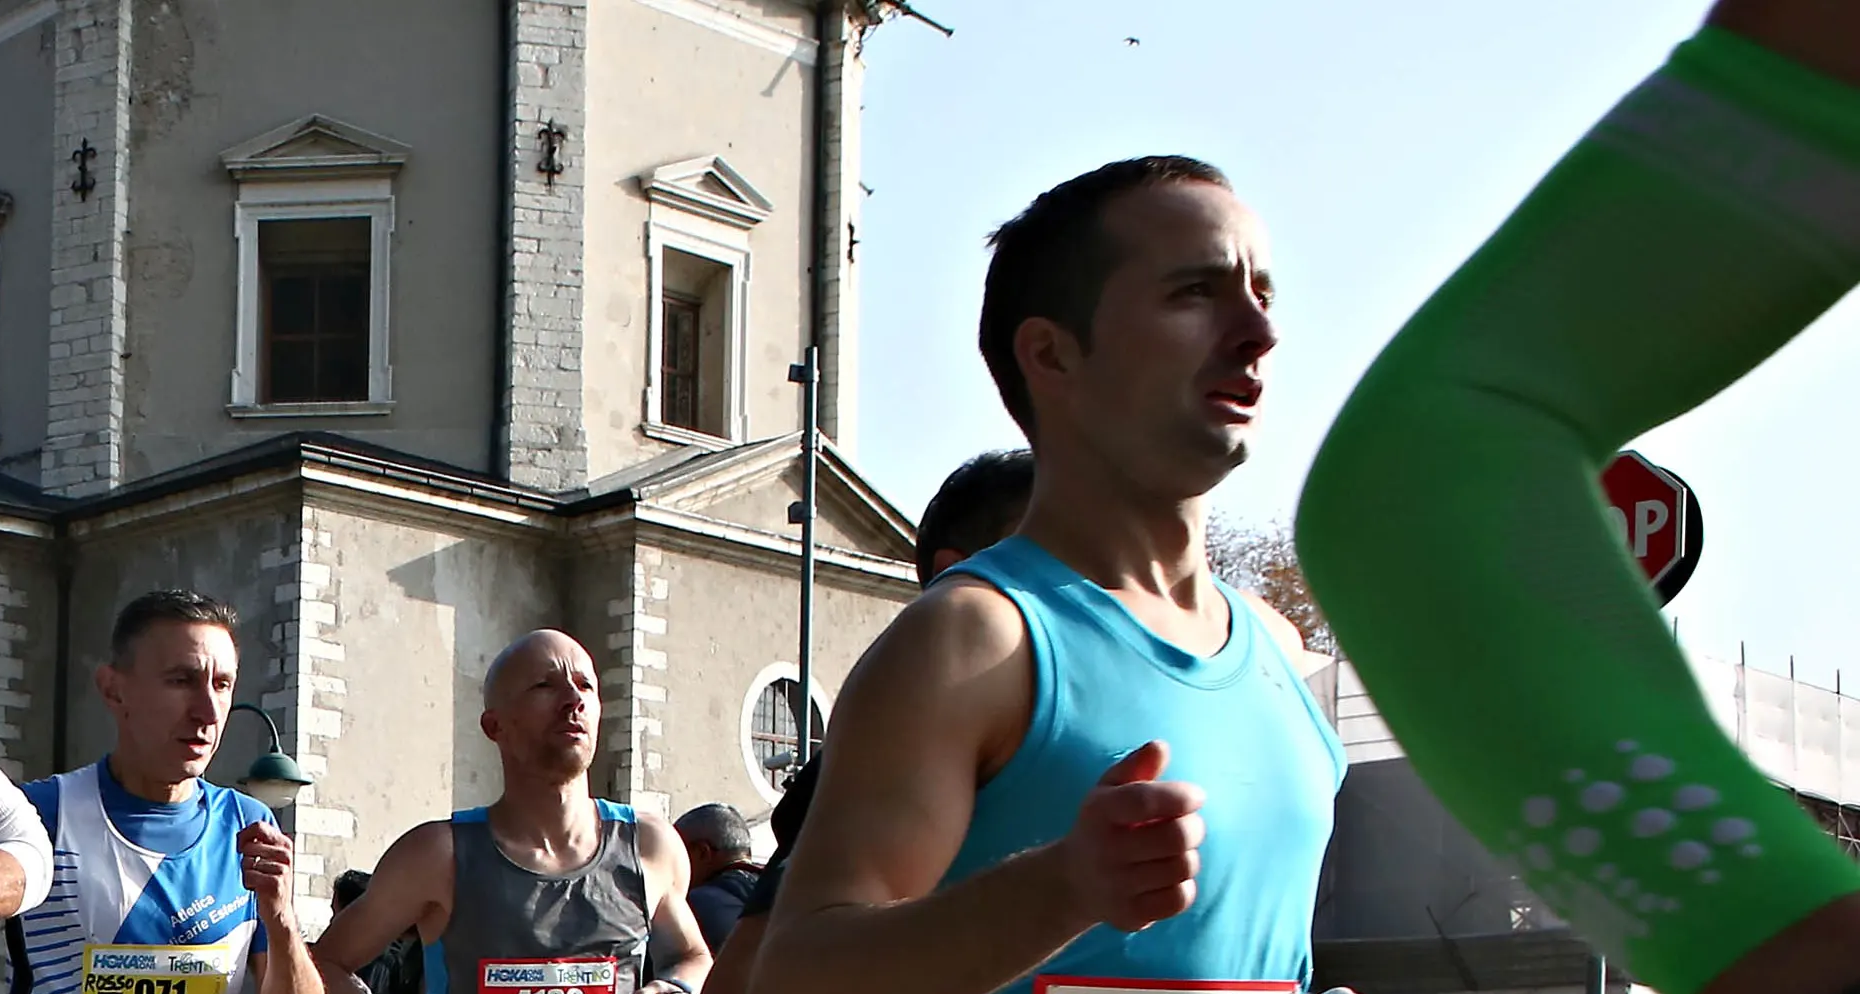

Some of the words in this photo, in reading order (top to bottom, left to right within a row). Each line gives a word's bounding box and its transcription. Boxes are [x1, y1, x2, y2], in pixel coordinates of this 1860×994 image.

[170, 893, 216, 928] Atletica
[93, 954, 140, 969] HOKA
[487, 969, 528, 982] HOKA
[557, 968, 611, 984] TRENTINO
